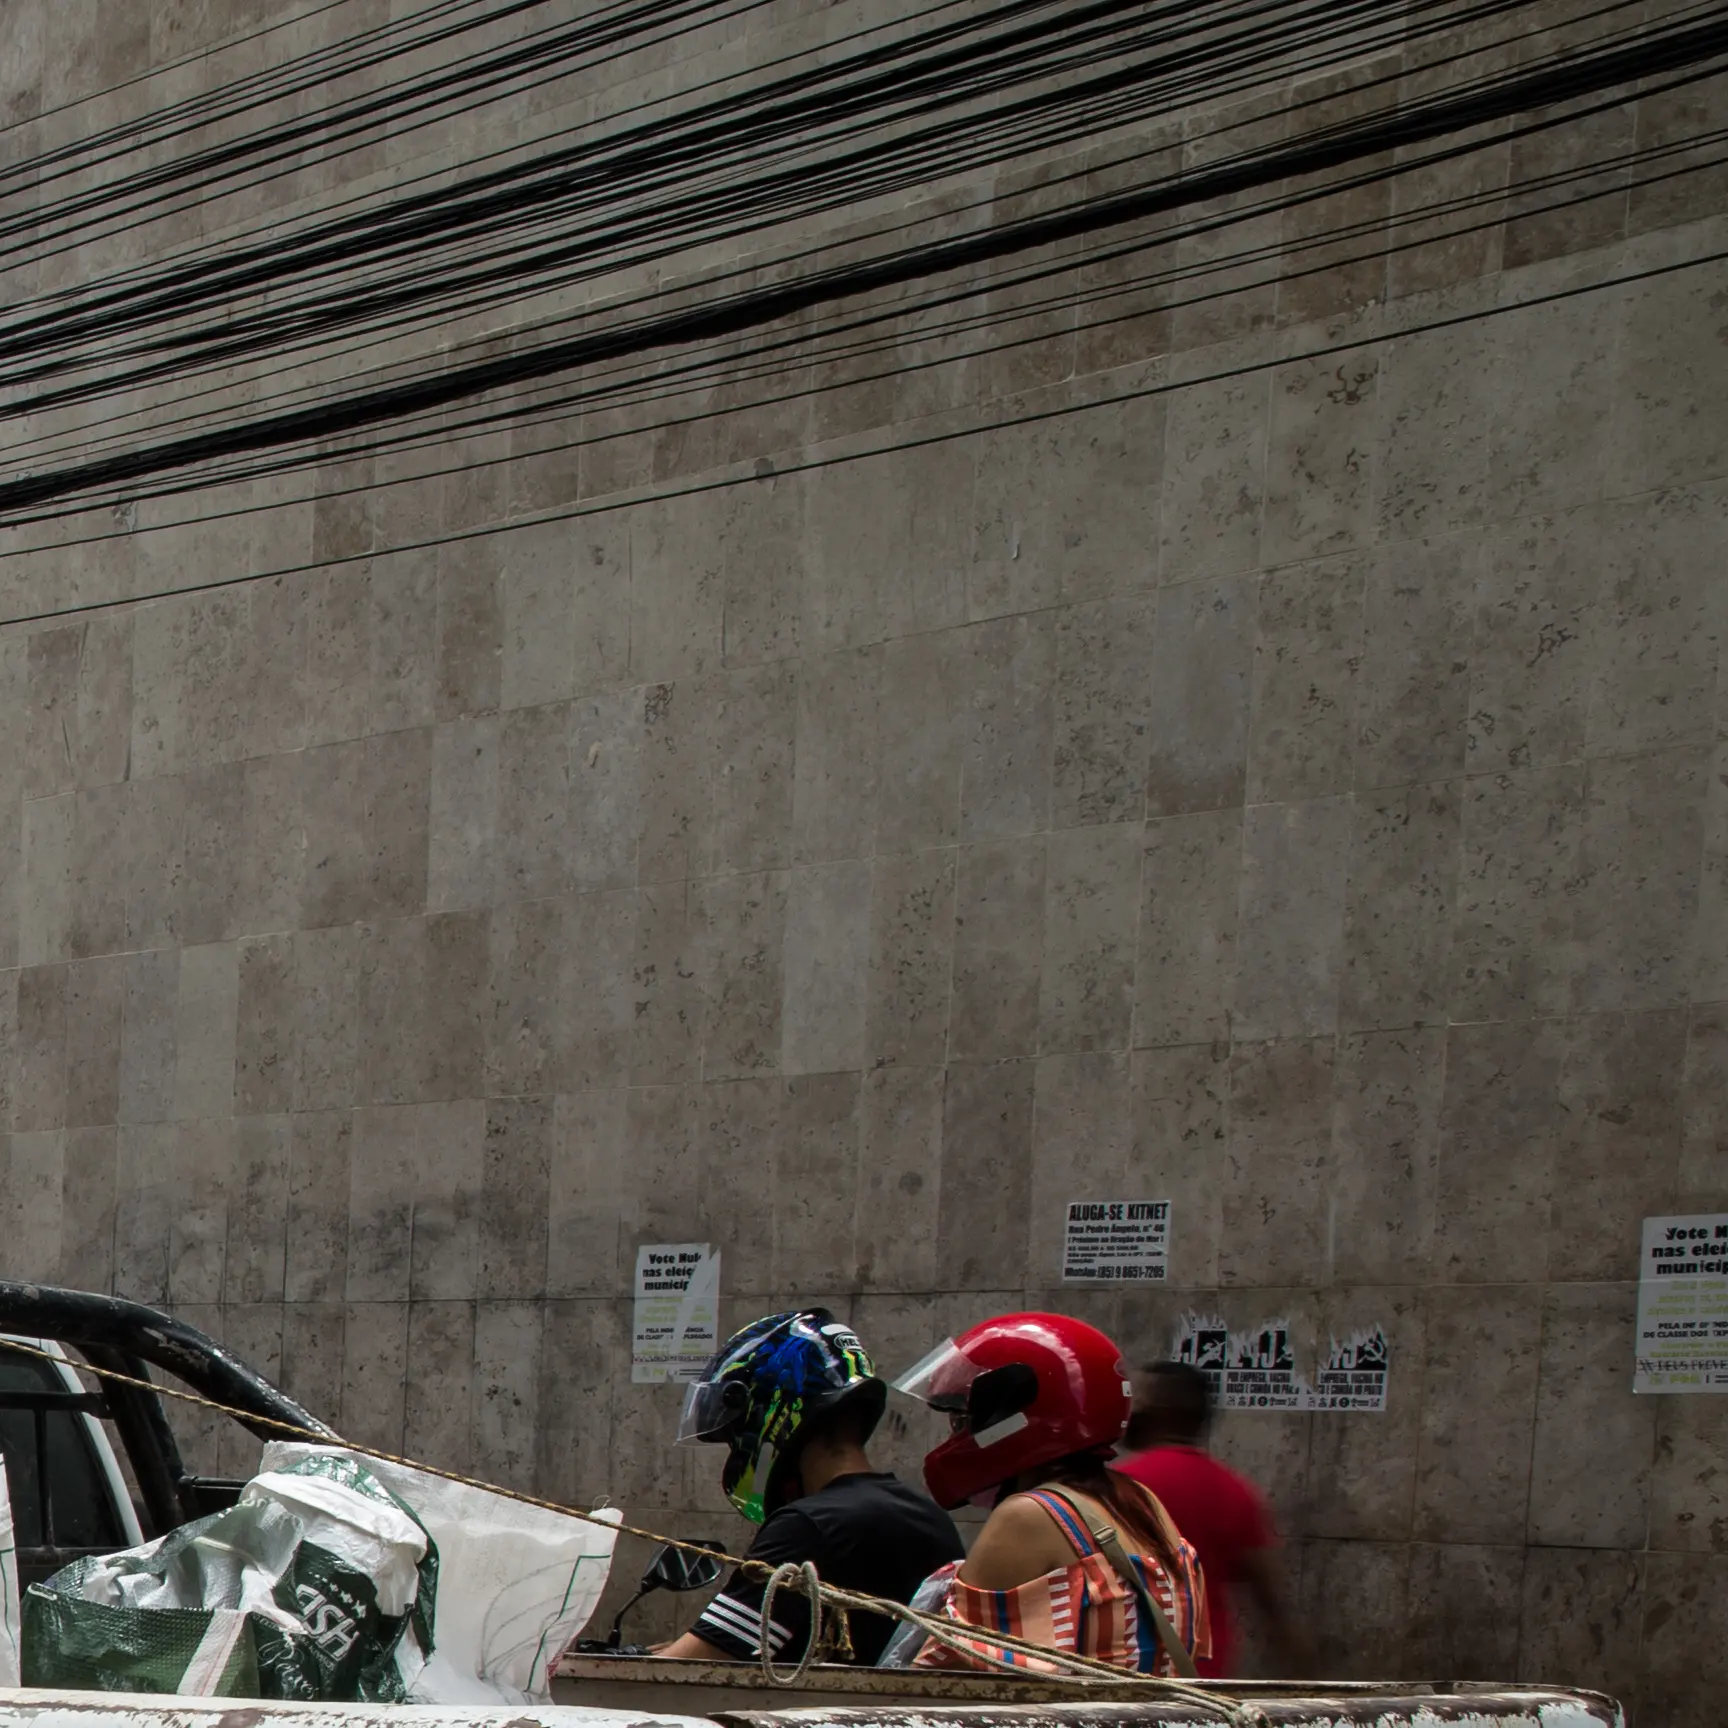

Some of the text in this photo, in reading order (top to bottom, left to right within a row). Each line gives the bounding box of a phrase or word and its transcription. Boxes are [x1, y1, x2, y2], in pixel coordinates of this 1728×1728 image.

[1069, 1203, 1169, 1221] ALUGA-SE KITNET
[1665, 1227, 1709, 1241] Vote
[1652, 1242, 1728, 1258] nas elei
[648, 1252, 702, 1265] Vote Nul
[643, 1266, 696, 1279] nas eleiç
